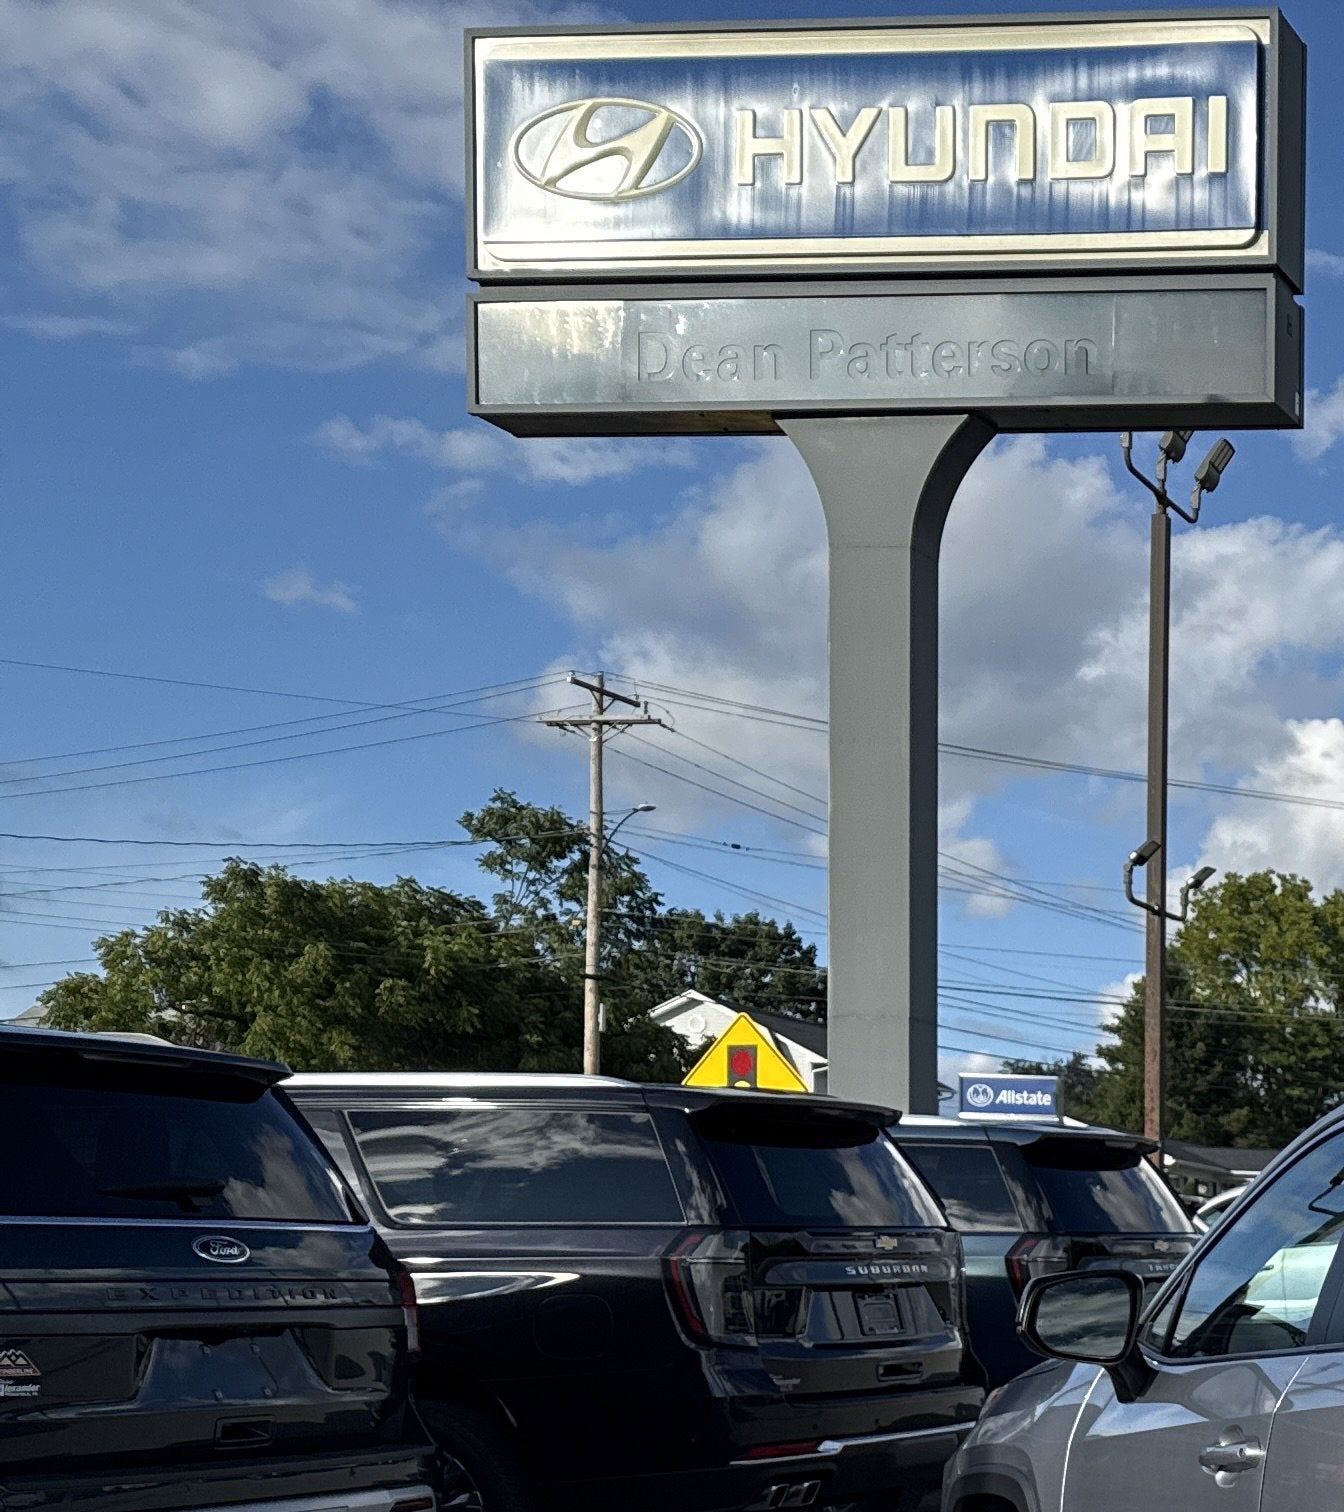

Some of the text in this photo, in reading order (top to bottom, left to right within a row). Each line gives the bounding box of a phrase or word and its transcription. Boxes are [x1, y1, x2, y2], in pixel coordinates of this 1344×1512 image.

[736, 96, 1229, 187] HYUNDAI
[637, 327, 1099, 382] Dean Patterson
[995, 1089, 1052, 1106] Allstate
[209, 1239, 241, 1256] Ford
[845, 1264, 928, 1275] SUBURBAN
[105, 1286, 338, 1301] EXPEDITION
